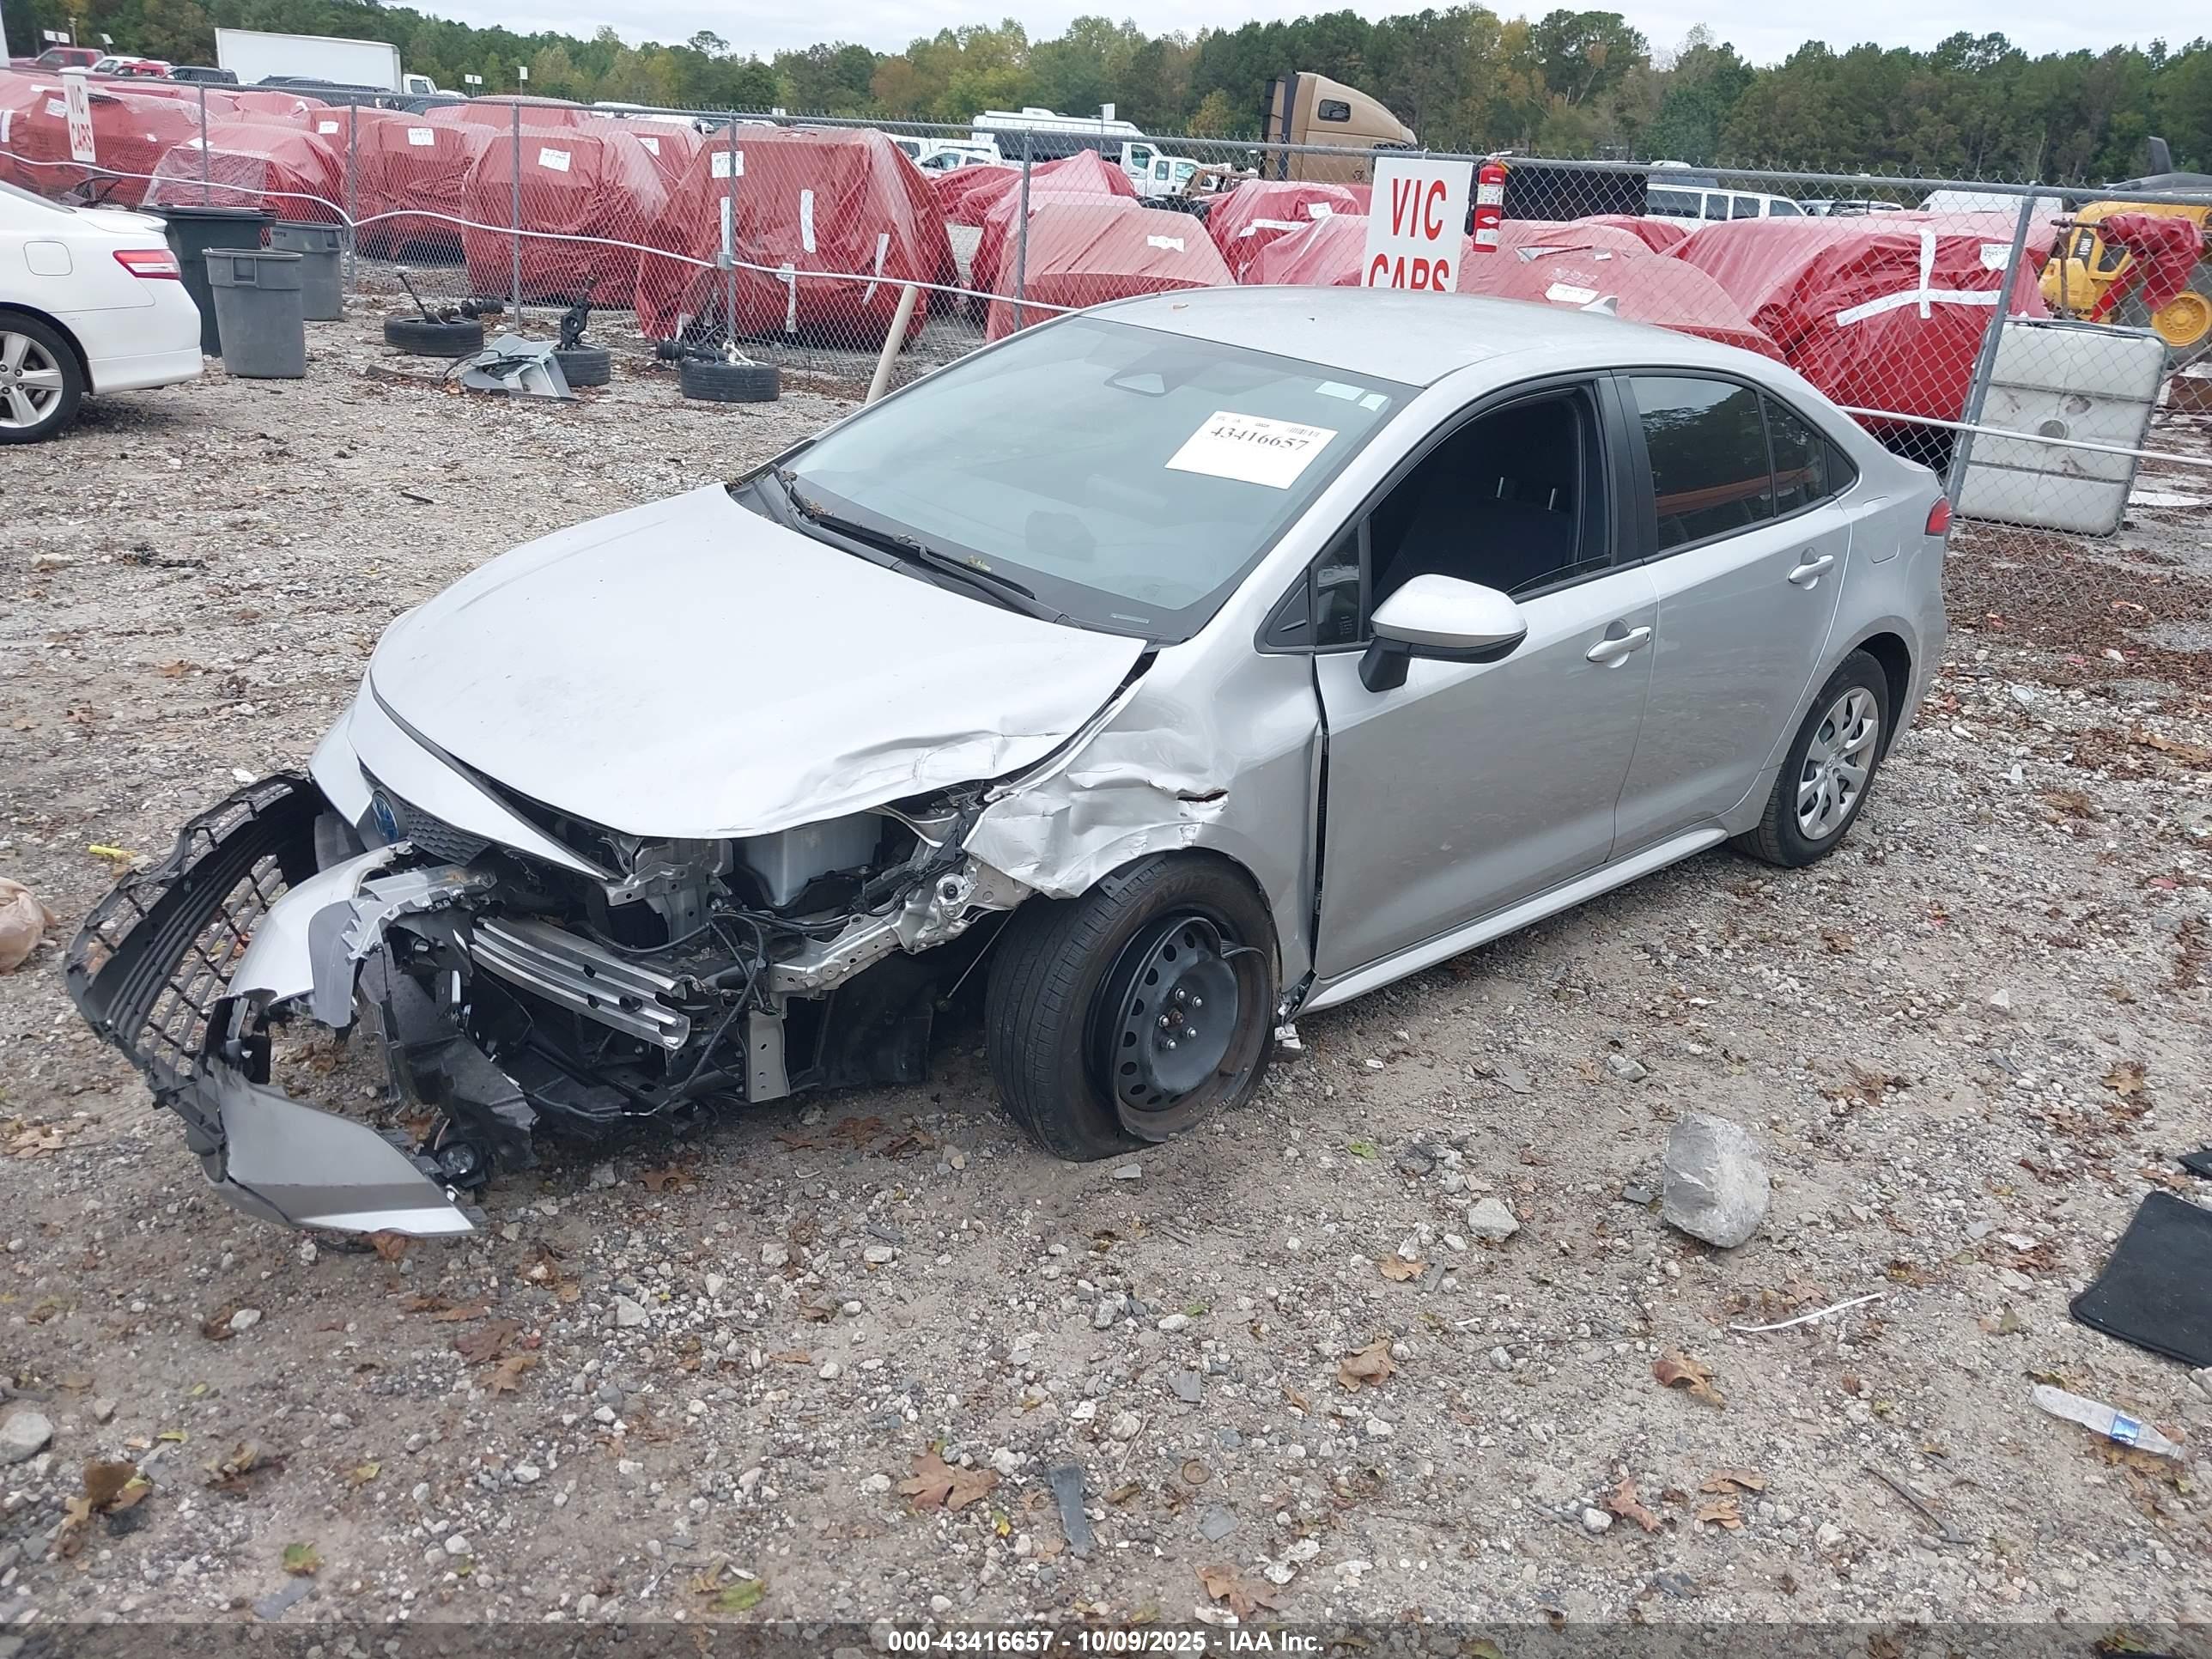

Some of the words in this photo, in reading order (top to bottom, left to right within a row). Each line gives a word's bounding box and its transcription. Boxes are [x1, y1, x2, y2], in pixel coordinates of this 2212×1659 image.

[71, 122, 92, 153] CARS
[1392, 179, 1446, 240] VIC
[1210, 426, 1309, 450] 43416657
